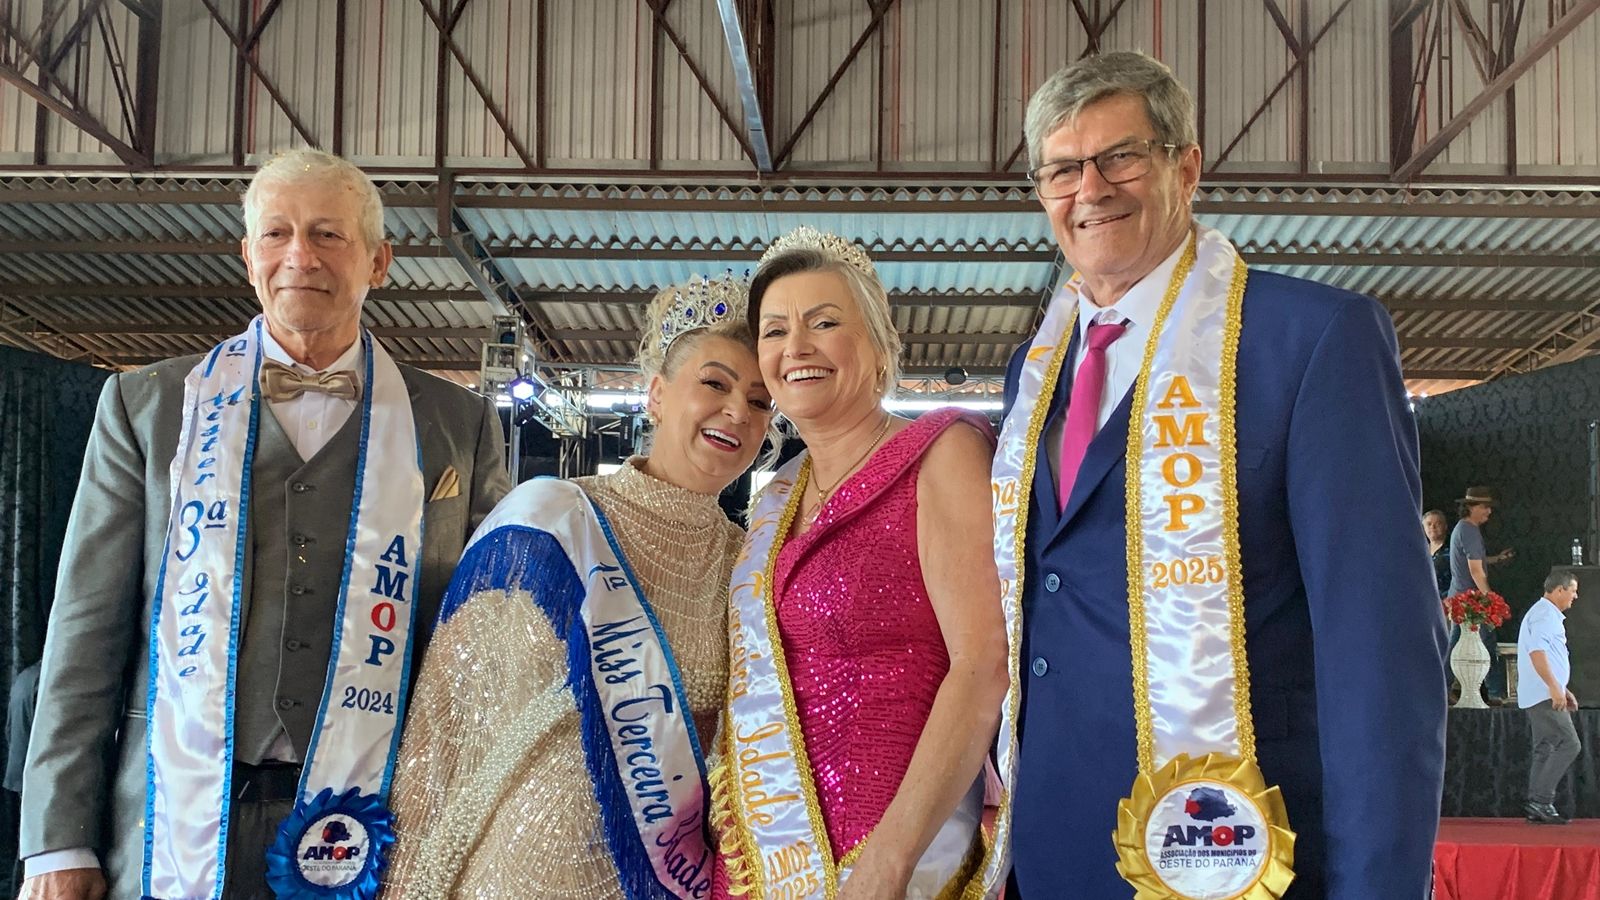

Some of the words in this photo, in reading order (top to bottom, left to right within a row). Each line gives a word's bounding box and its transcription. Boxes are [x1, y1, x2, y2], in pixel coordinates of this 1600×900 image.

[1152, 375, 1210, 532] AMOP
[1152, 556, 1225, 589] 2025
[364, 534, 410, 668] AMOP
[177, 572, 210, 678] Idade
[591, 615, 650, 684] Miss
[341, 685, 395, 715] 2024
[609, 684, 684, 824] Terceira
[735, 721, 799, 826] Idade
[303, 846, 360, 861] AMOP
[1162, 825, 1256, 848] AMOP
[1197, 850, 1210, 858] DOS
[767, 840, 812, 886] AMOP
[1159, 858, 1193, 870] OESTE
[1195, 859, 1211, 869] DO
